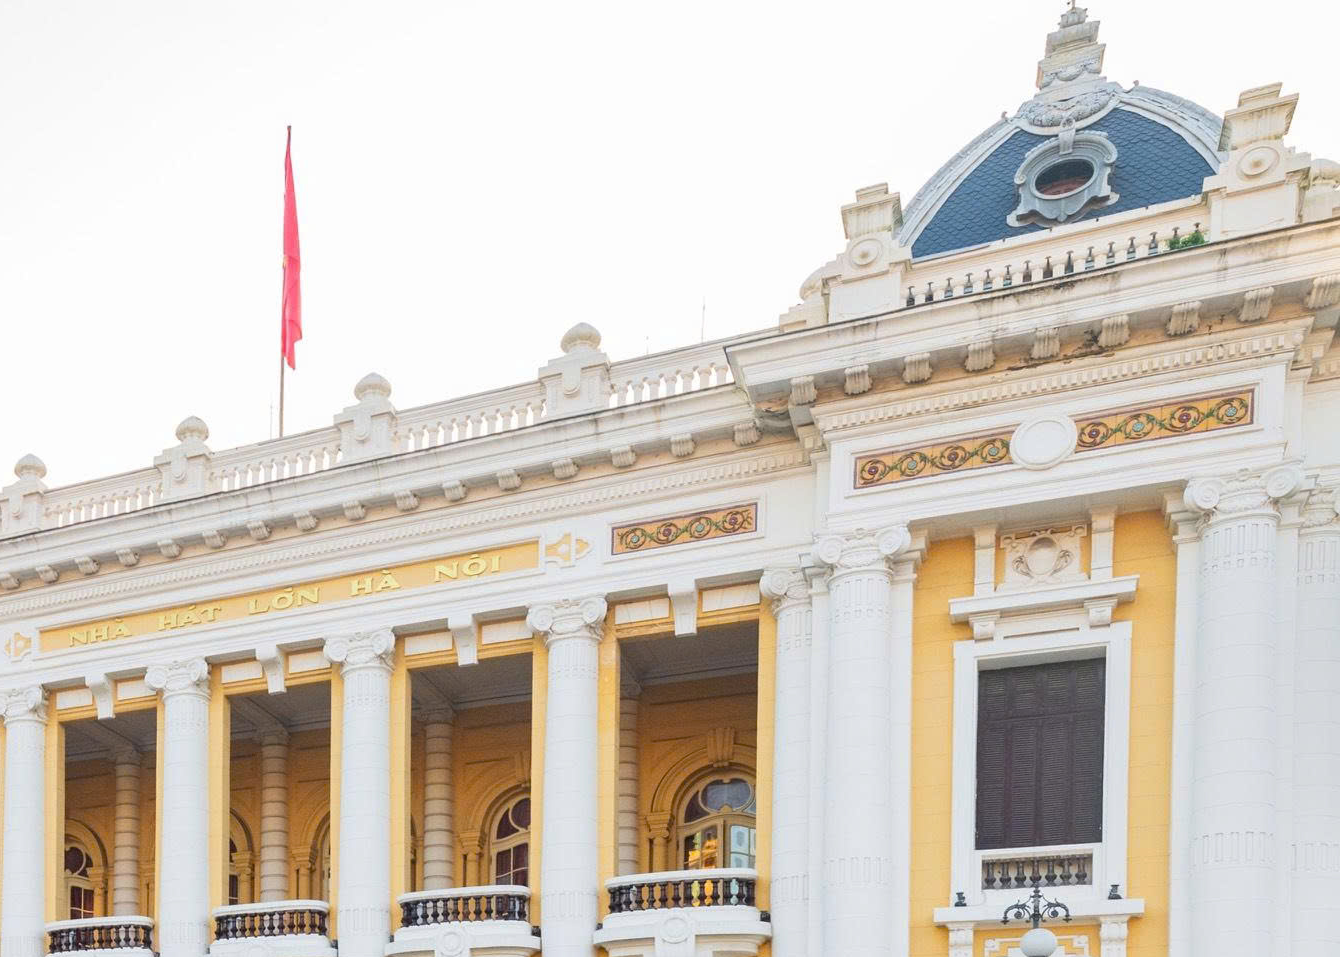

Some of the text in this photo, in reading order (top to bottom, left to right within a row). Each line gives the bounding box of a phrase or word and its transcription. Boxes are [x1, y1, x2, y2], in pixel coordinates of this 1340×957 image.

[68, 618, 132, 647] NHÀ
[158, 605, 222, 631] HÁT
[350, 569, 401, 597] HÀ
